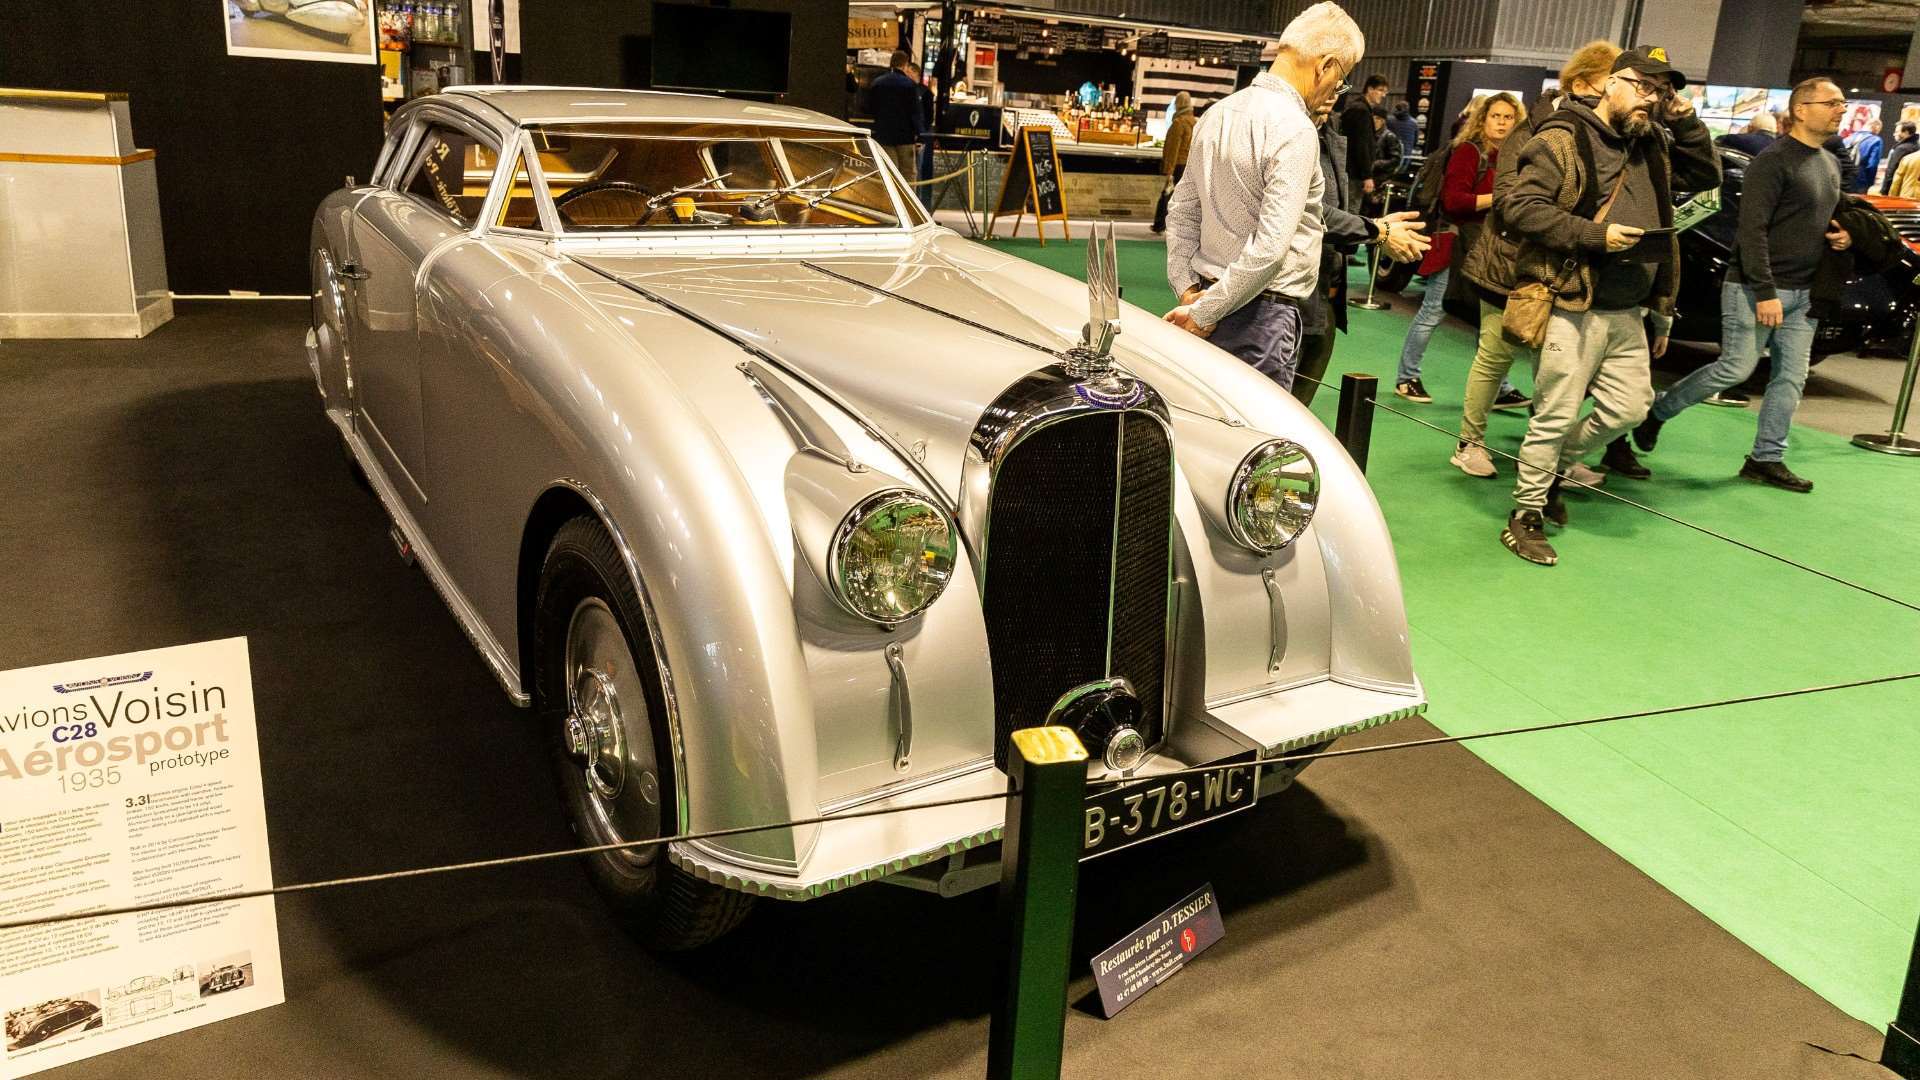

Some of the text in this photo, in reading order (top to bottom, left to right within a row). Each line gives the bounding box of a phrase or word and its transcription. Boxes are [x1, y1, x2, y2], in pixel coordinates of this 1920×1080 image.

[0, 681, 226, 733] vions Voisin
[52, 722, 98, 743] C28
[58, 748, 230, 794] 1935 prototype
[1084, 767, 1244, 849] B-378-WC
[1100, 892, 1212, 977] Restaurée par D.TESSIER
